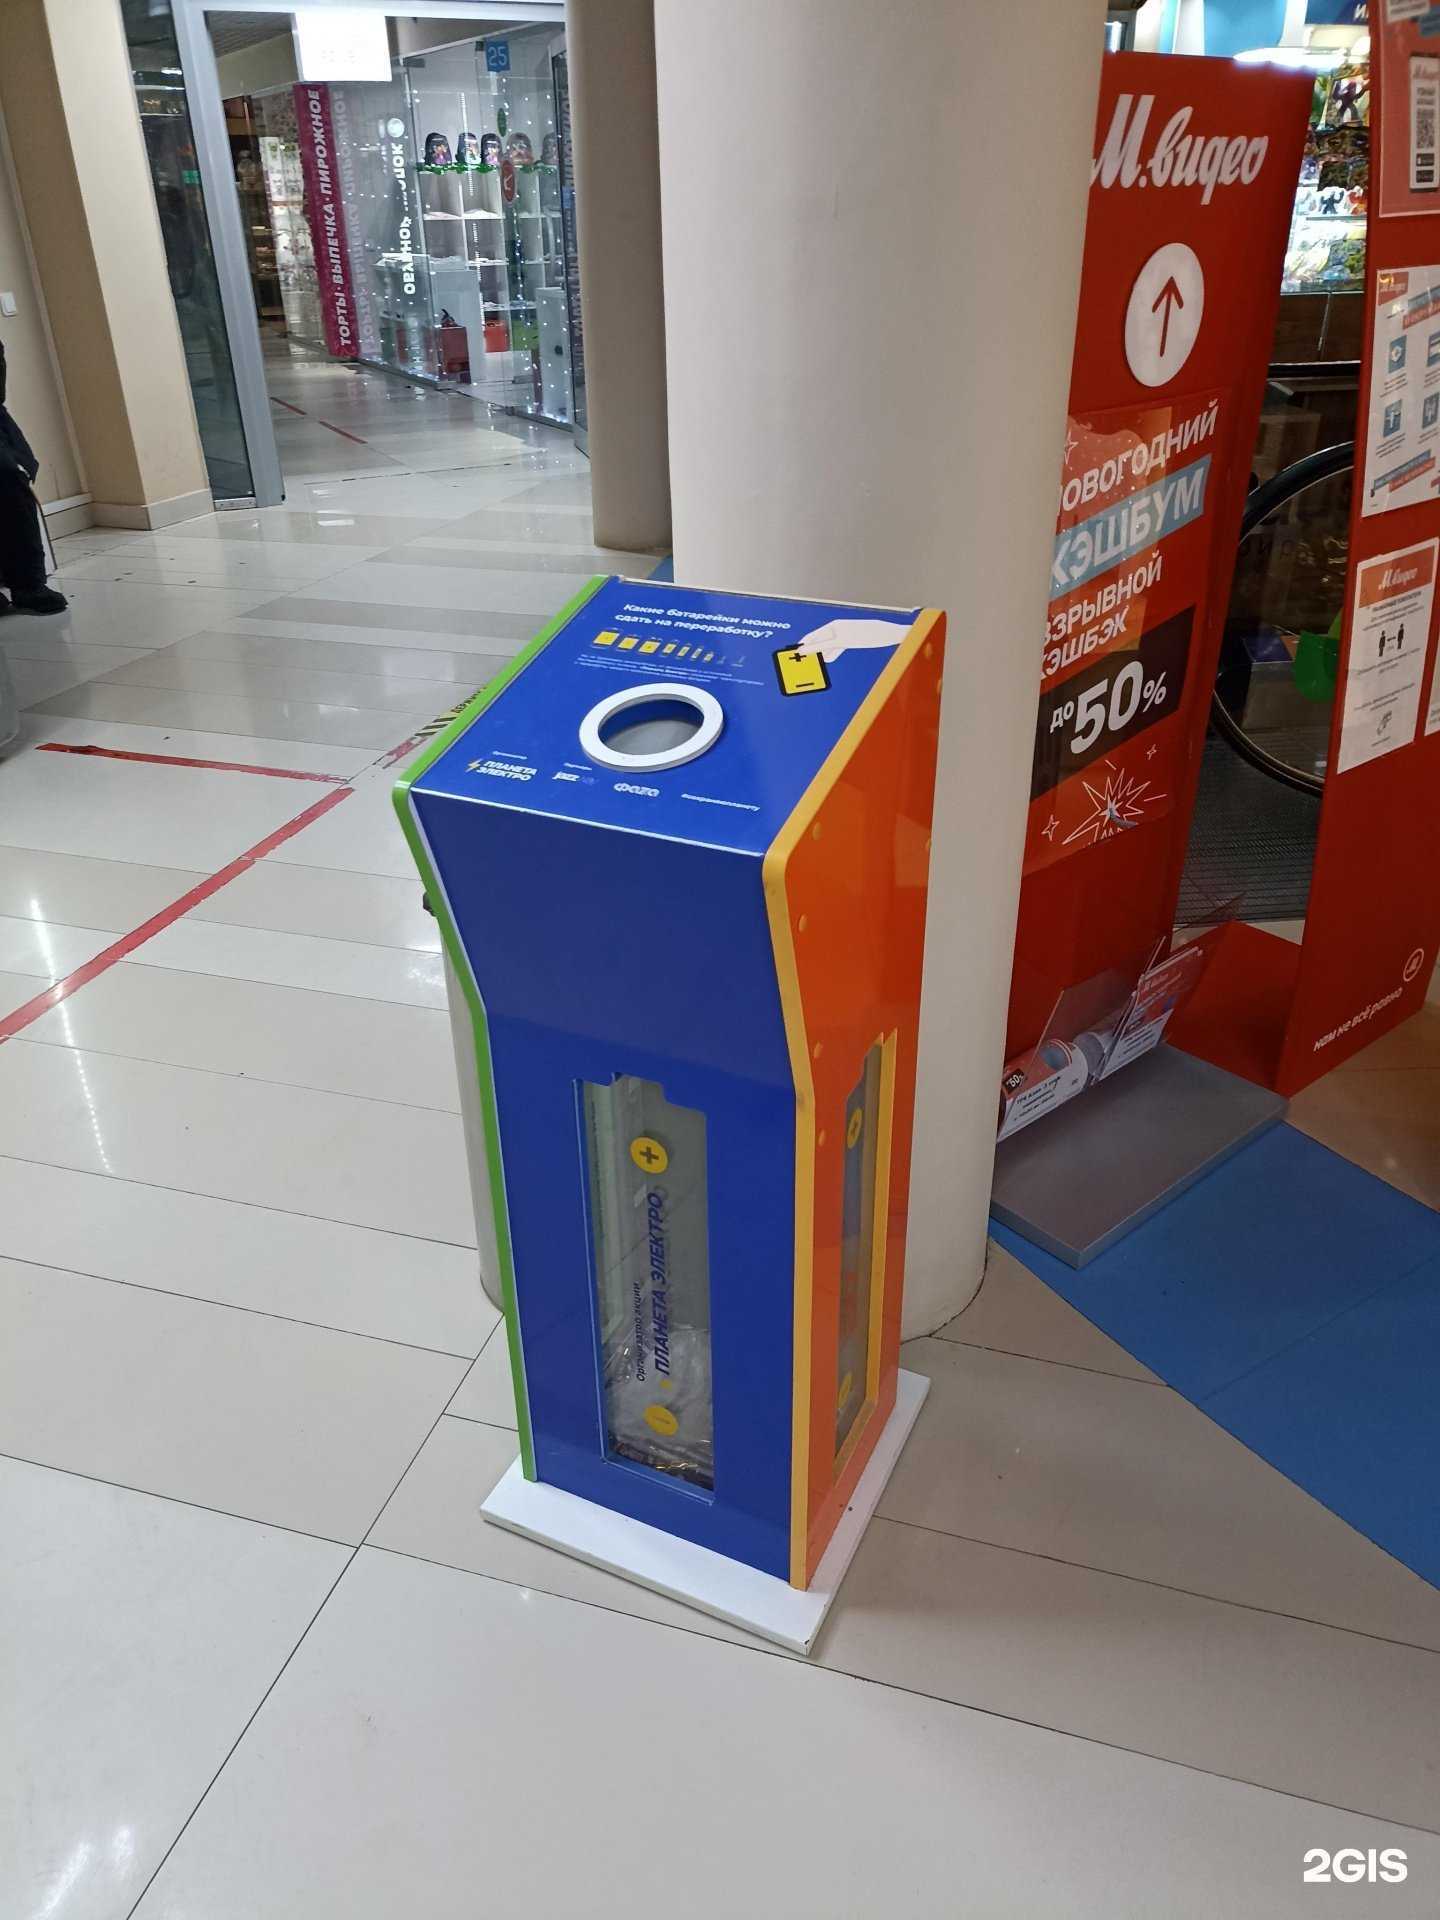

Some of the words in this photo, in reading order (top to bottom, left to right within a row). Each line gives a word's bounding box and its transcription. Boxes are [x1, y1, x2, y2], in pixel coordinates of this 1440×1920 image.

[488, 46, 508, 65] 25
[307, 90, 333, 196] ПИРОЖНОЕ
[1089, 94, 1269, 206] М.видео
[319, 203, 345, 285] ВЫПЕЧКА
[335, 295, 352, 346] ТОРТЫ
[1057, 399, 1219, 516] ОВОГОДНИЙ
[615, 614, 652, 624] сдать
[654, 619, 674, 627] на
[674, 621, 774, 638] переработку?
[623, 604, 664, 615] Какие
[667, 608, 741, 624] батарейки
[742, 618, 791, 630] можно
[1071, 661, 1167, 754] 50%
[476, 766, 532, 781] ЭЛЕКТРО
[483, 760, 538, 776] ПЛАНЕТА
[647, 1192, 667, 1286] ЭЛЕКТРО
[652, 1290, 670, 1376] ПЛАНЕТА
